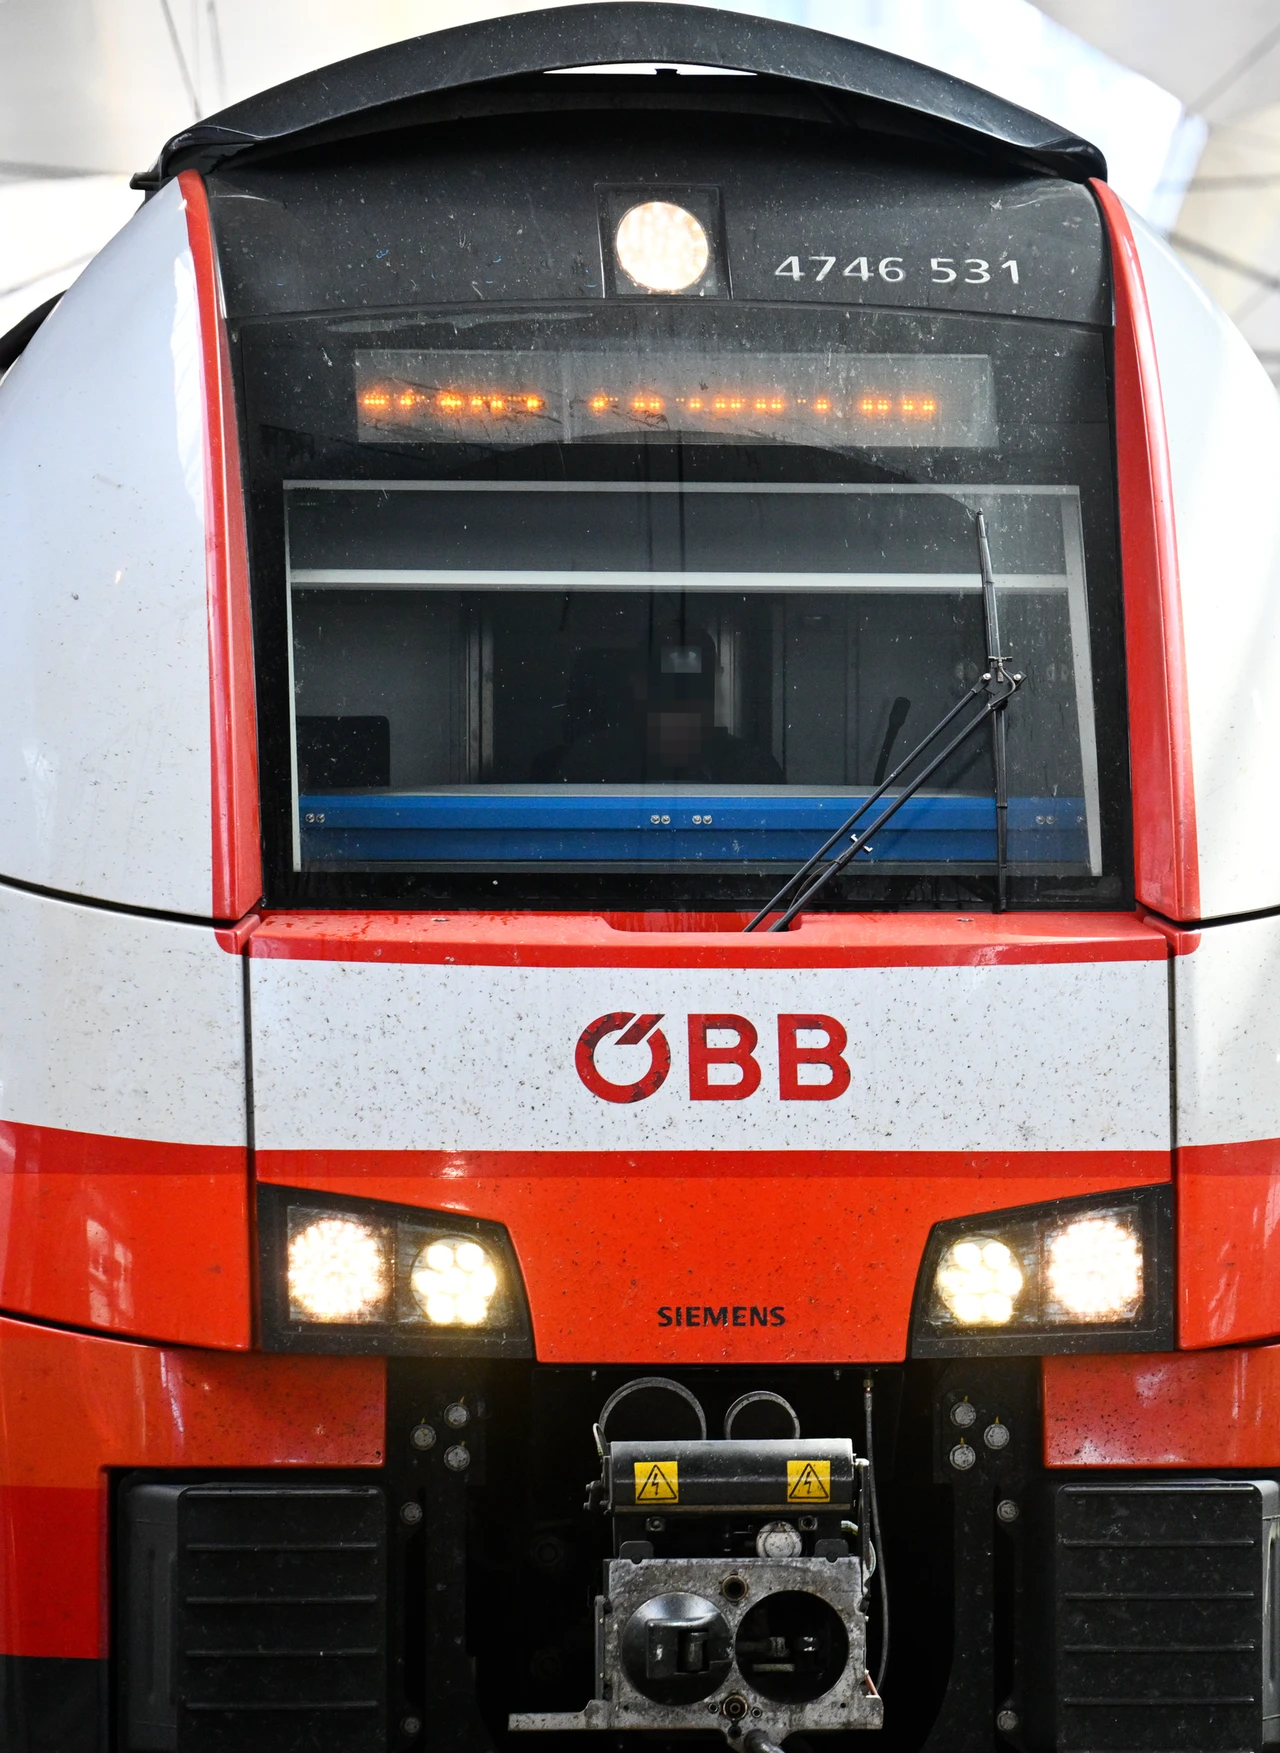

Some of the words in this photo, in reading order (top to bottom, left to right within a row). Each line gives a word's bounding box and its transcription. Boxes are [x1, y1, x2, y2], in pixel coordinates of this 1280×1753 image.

[774, 255, 906, 282] 4746
[930, 257, 1020, 284] 531
[574, 1011, 851, 1103] ÖBB
[656, 1305, 786, 1327] SIEMENS
